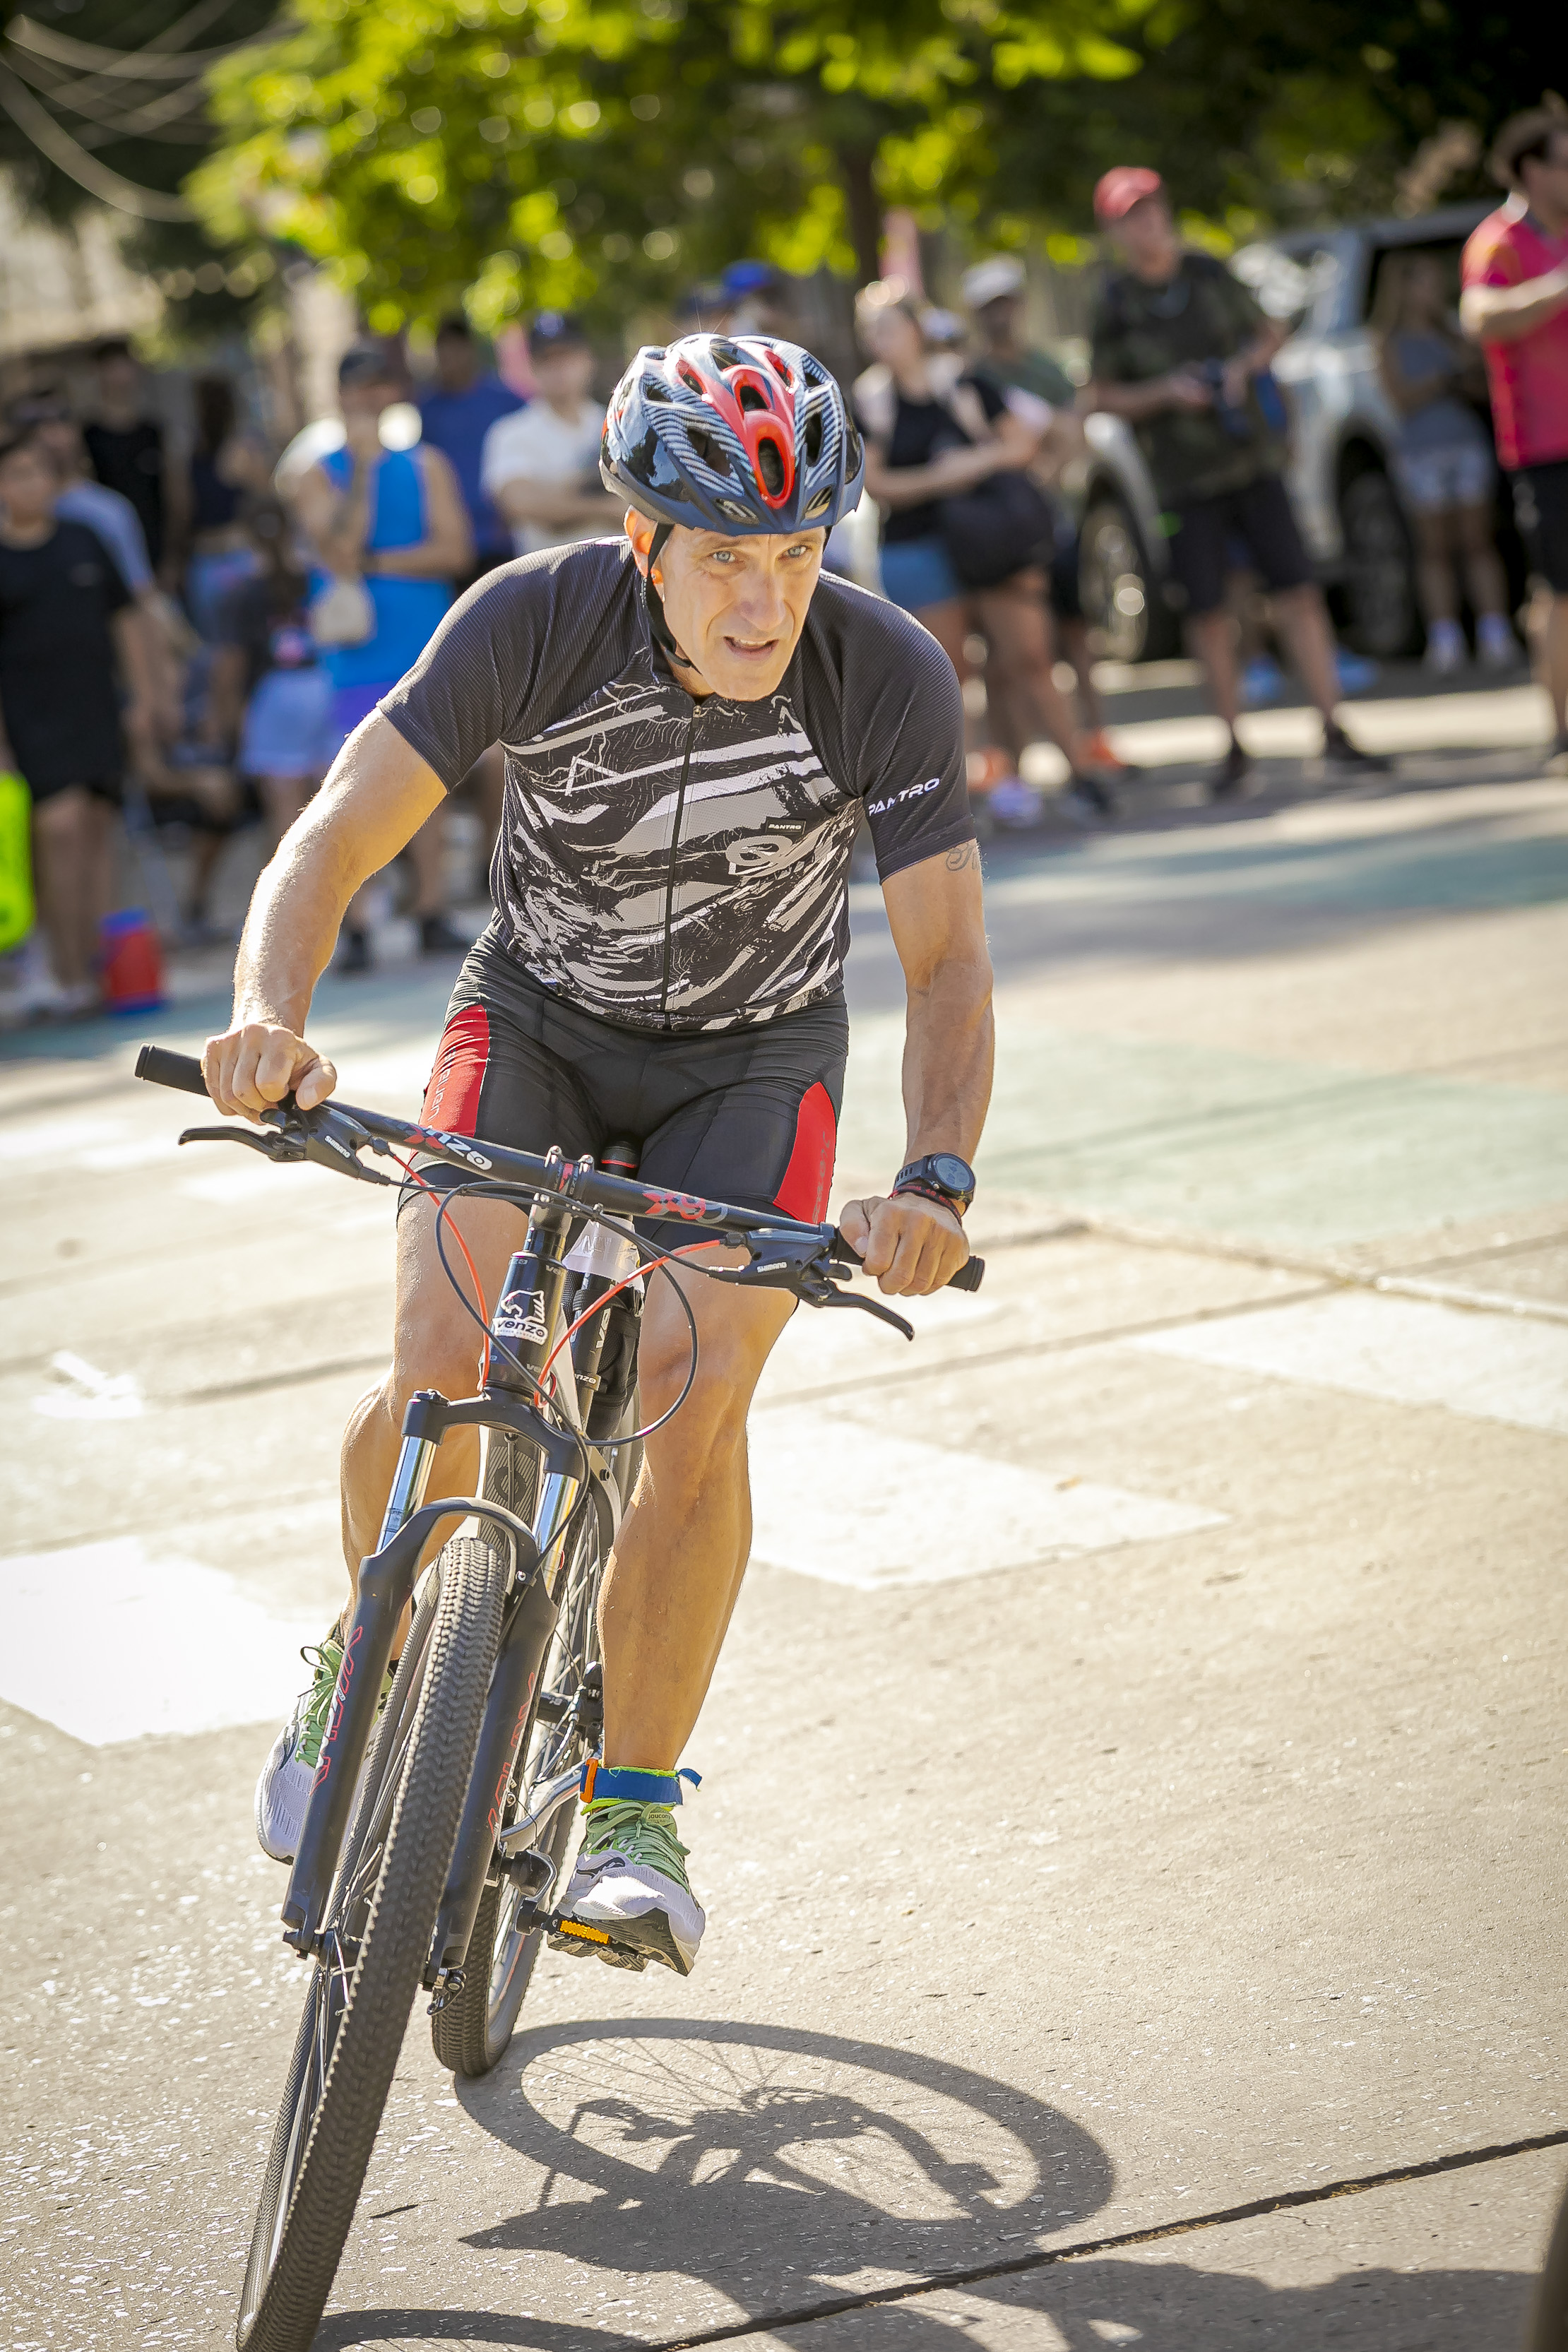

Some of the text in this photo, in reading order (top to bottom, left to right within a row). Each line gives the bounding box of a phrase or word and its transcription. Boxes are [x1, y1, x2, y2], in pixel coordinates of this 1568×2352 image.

[867, 778, 941, 816] PANTRO
[324, 1135, 351, 1158] SHIMANO
[756, 1261, 788, 1273] SHIMANO
